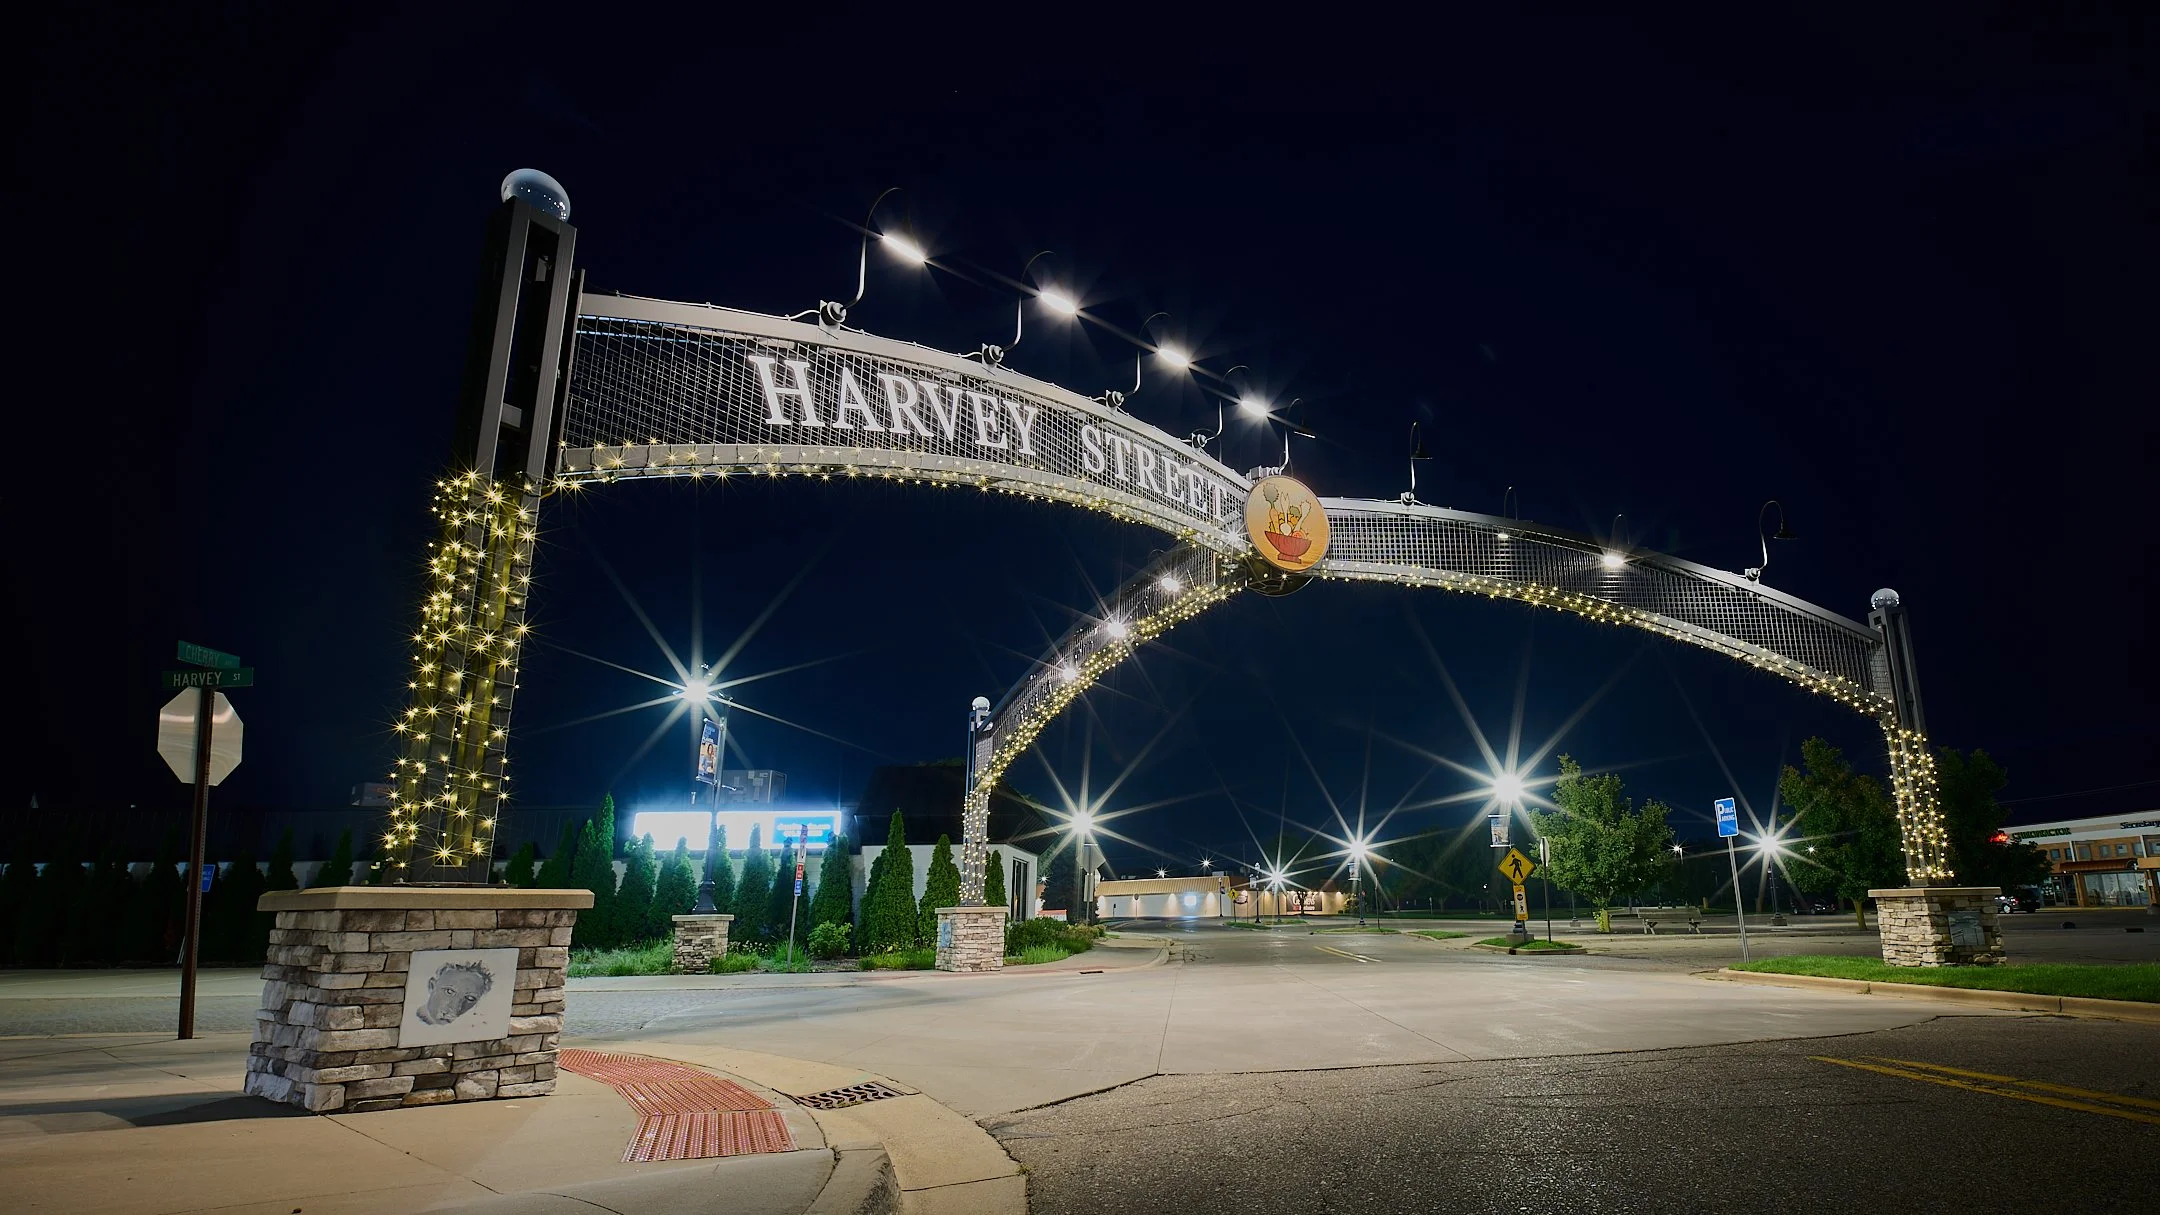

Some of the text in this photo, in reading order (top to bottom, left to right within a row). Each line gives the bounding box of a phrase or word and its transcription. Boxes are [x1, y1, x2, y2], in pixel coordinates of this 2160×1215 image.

[748, 355, 1228, 522] HARVEY STREET
[185, 645, 220, 667] CHERRY
[173, 671, 222, 687] HARVEY
